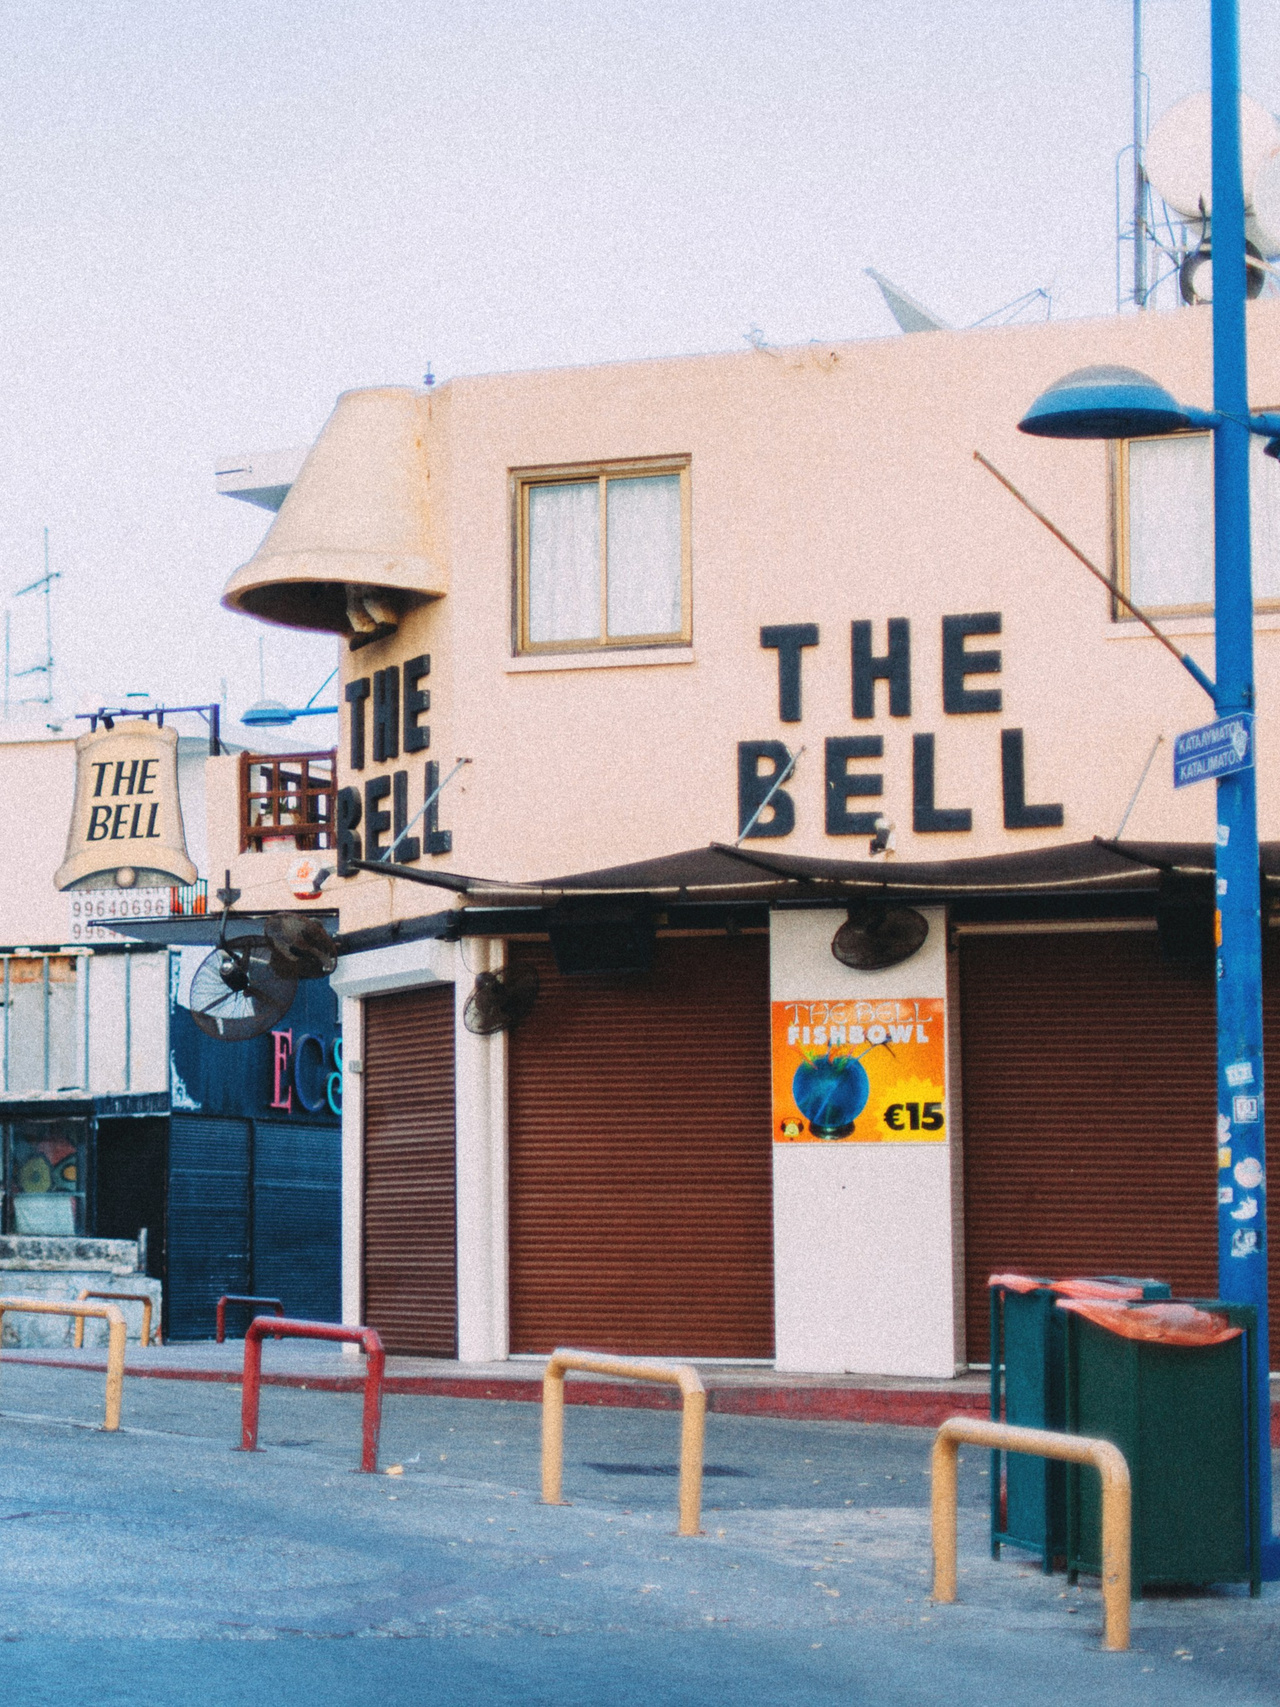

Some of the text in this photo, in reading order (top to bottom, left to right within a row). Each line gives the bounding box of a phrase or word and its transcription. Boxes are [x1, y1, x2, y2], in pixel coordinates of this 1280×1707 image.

[760, 611, 1002, 722] THE
[345, 654, 431, 770] THE
[92, 759, 160, 798] THE
[737, 728, 1064, 839] BELL
[86, 801, 161, 842] BELL
[336, 761, 453, 877] BELL
[72, 899, 164, 917] 99640696
[784, 1001, 933, 1025] THE BELL
[787, 1024, 930, 1046] FISHBOWL
[884, 1102, 945, 1131] €15
